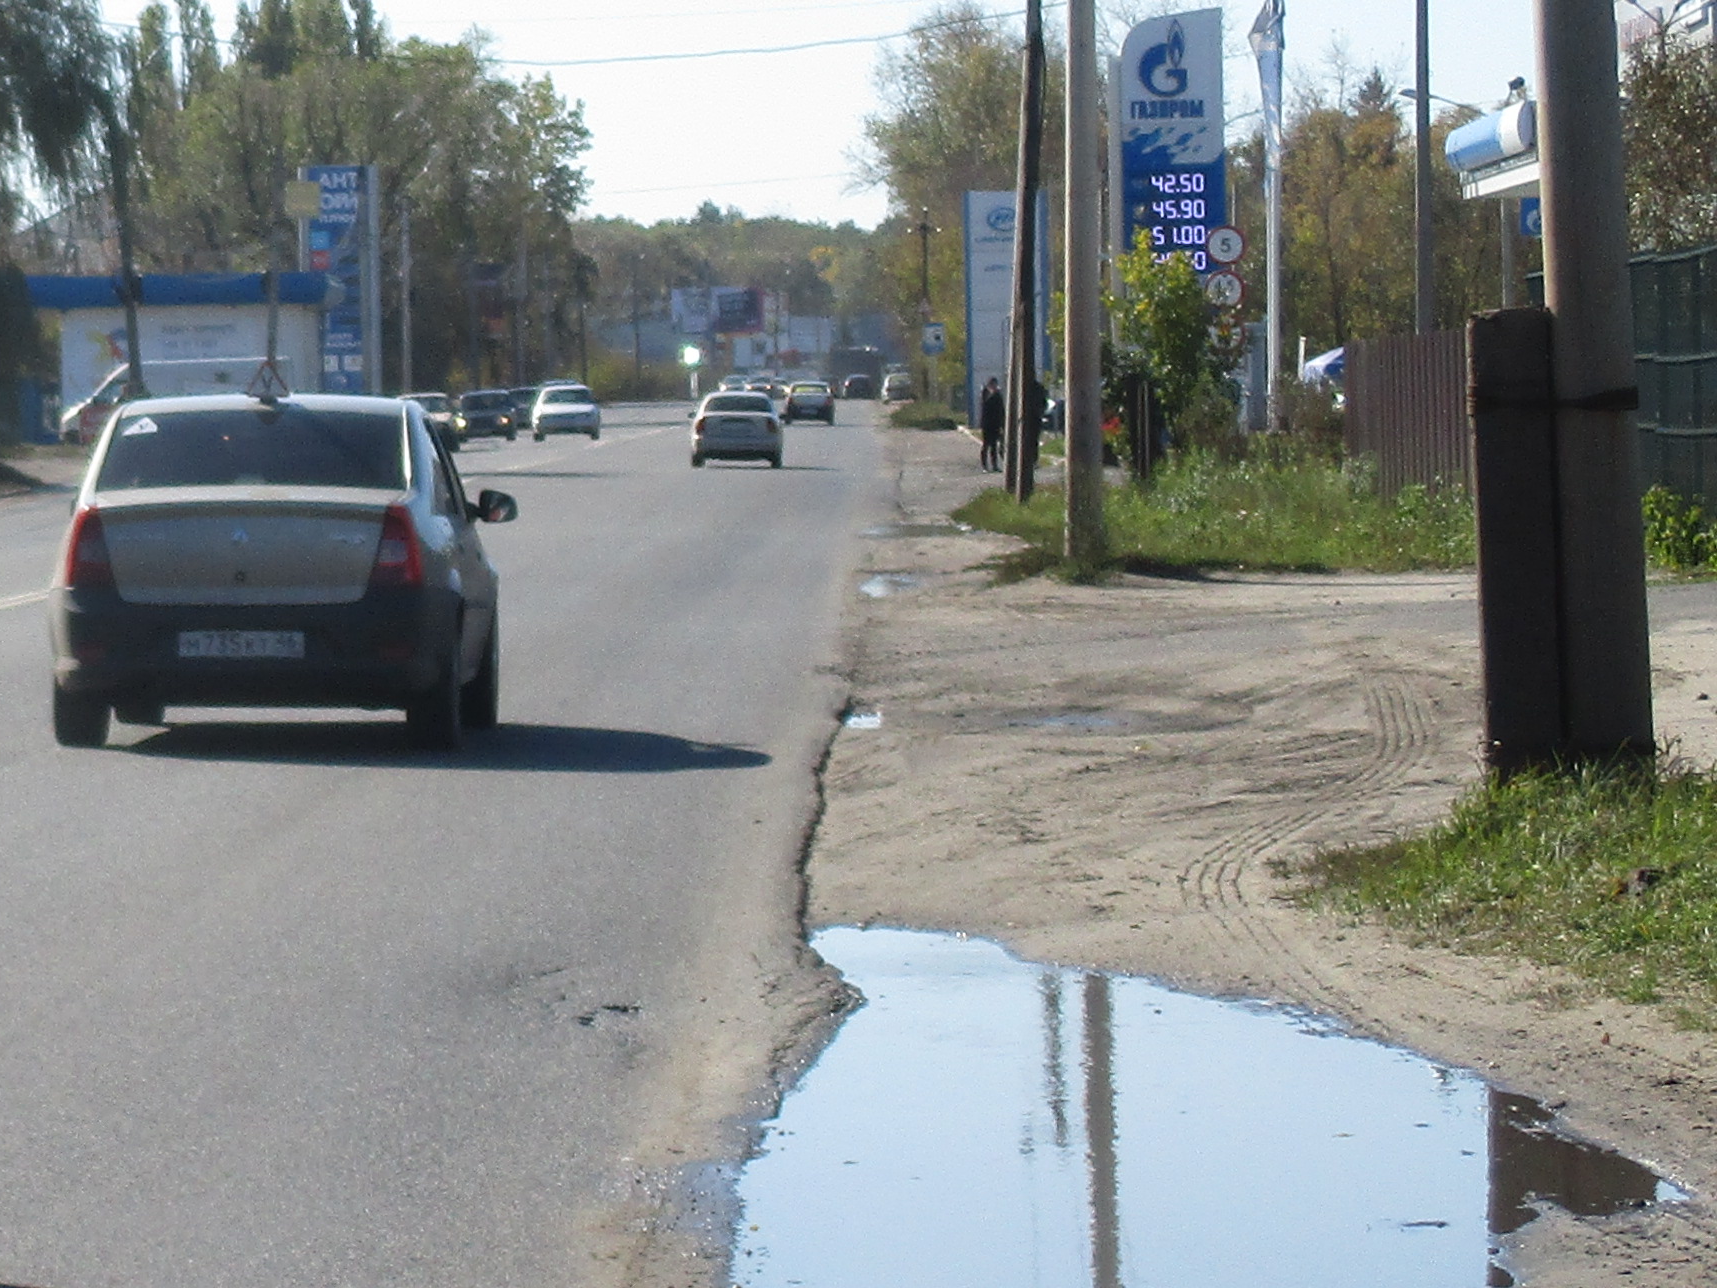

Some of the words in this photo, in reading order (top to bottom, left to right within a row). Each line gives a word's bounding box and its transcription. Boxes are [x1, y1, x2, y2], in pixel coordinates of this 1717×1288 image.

[1130, 99, 1204, 120] ГАЗПРОМ
[1150, 174, 1205, 194] 42.50
[1152, 200, 1206, 219] 45.90
[1219, 237, 1233, 253] 5
